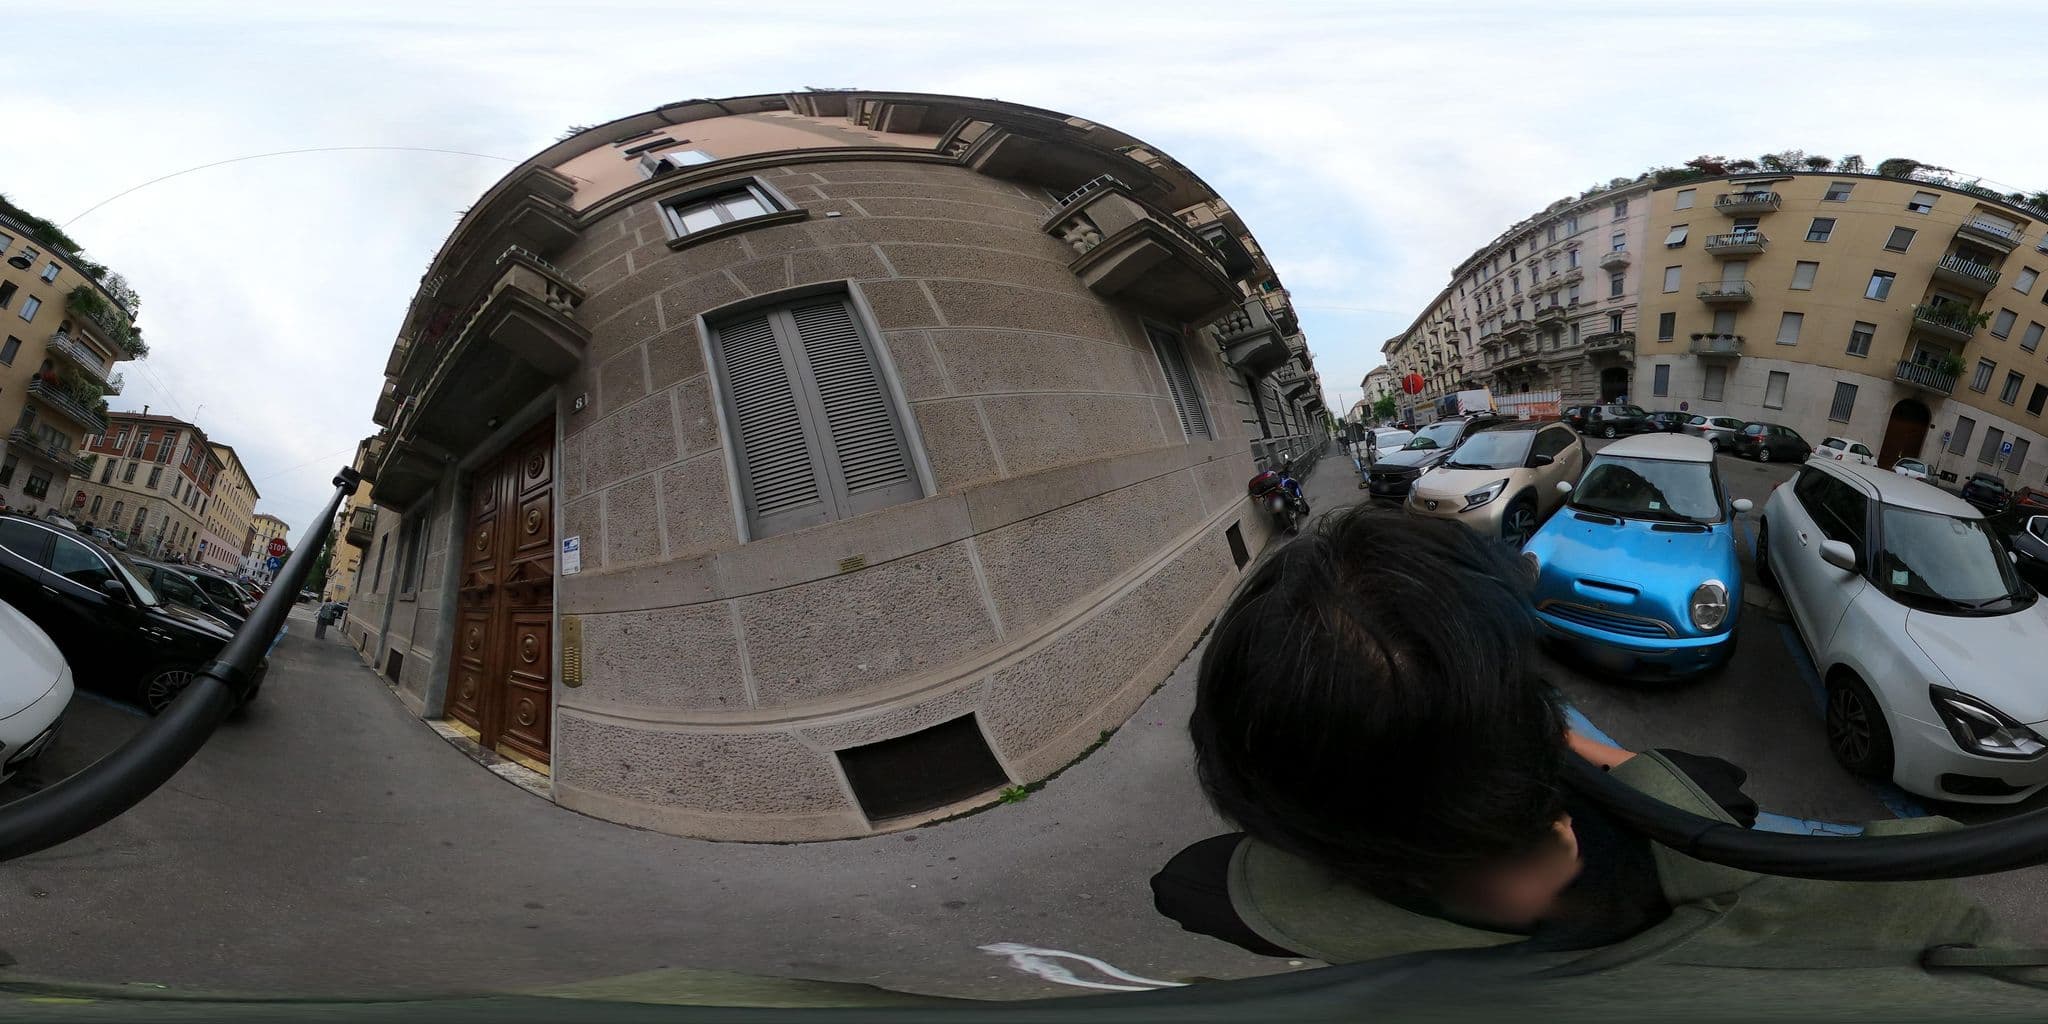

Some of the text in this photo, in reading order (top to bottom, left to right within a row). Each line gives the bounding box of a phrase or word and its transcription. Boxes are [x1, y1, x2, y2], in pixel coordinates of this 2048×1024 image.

[576, 397, 583, 409] 8
[2003, 443, 2011, 452] P
[268, 542, 286, 553] STOP
